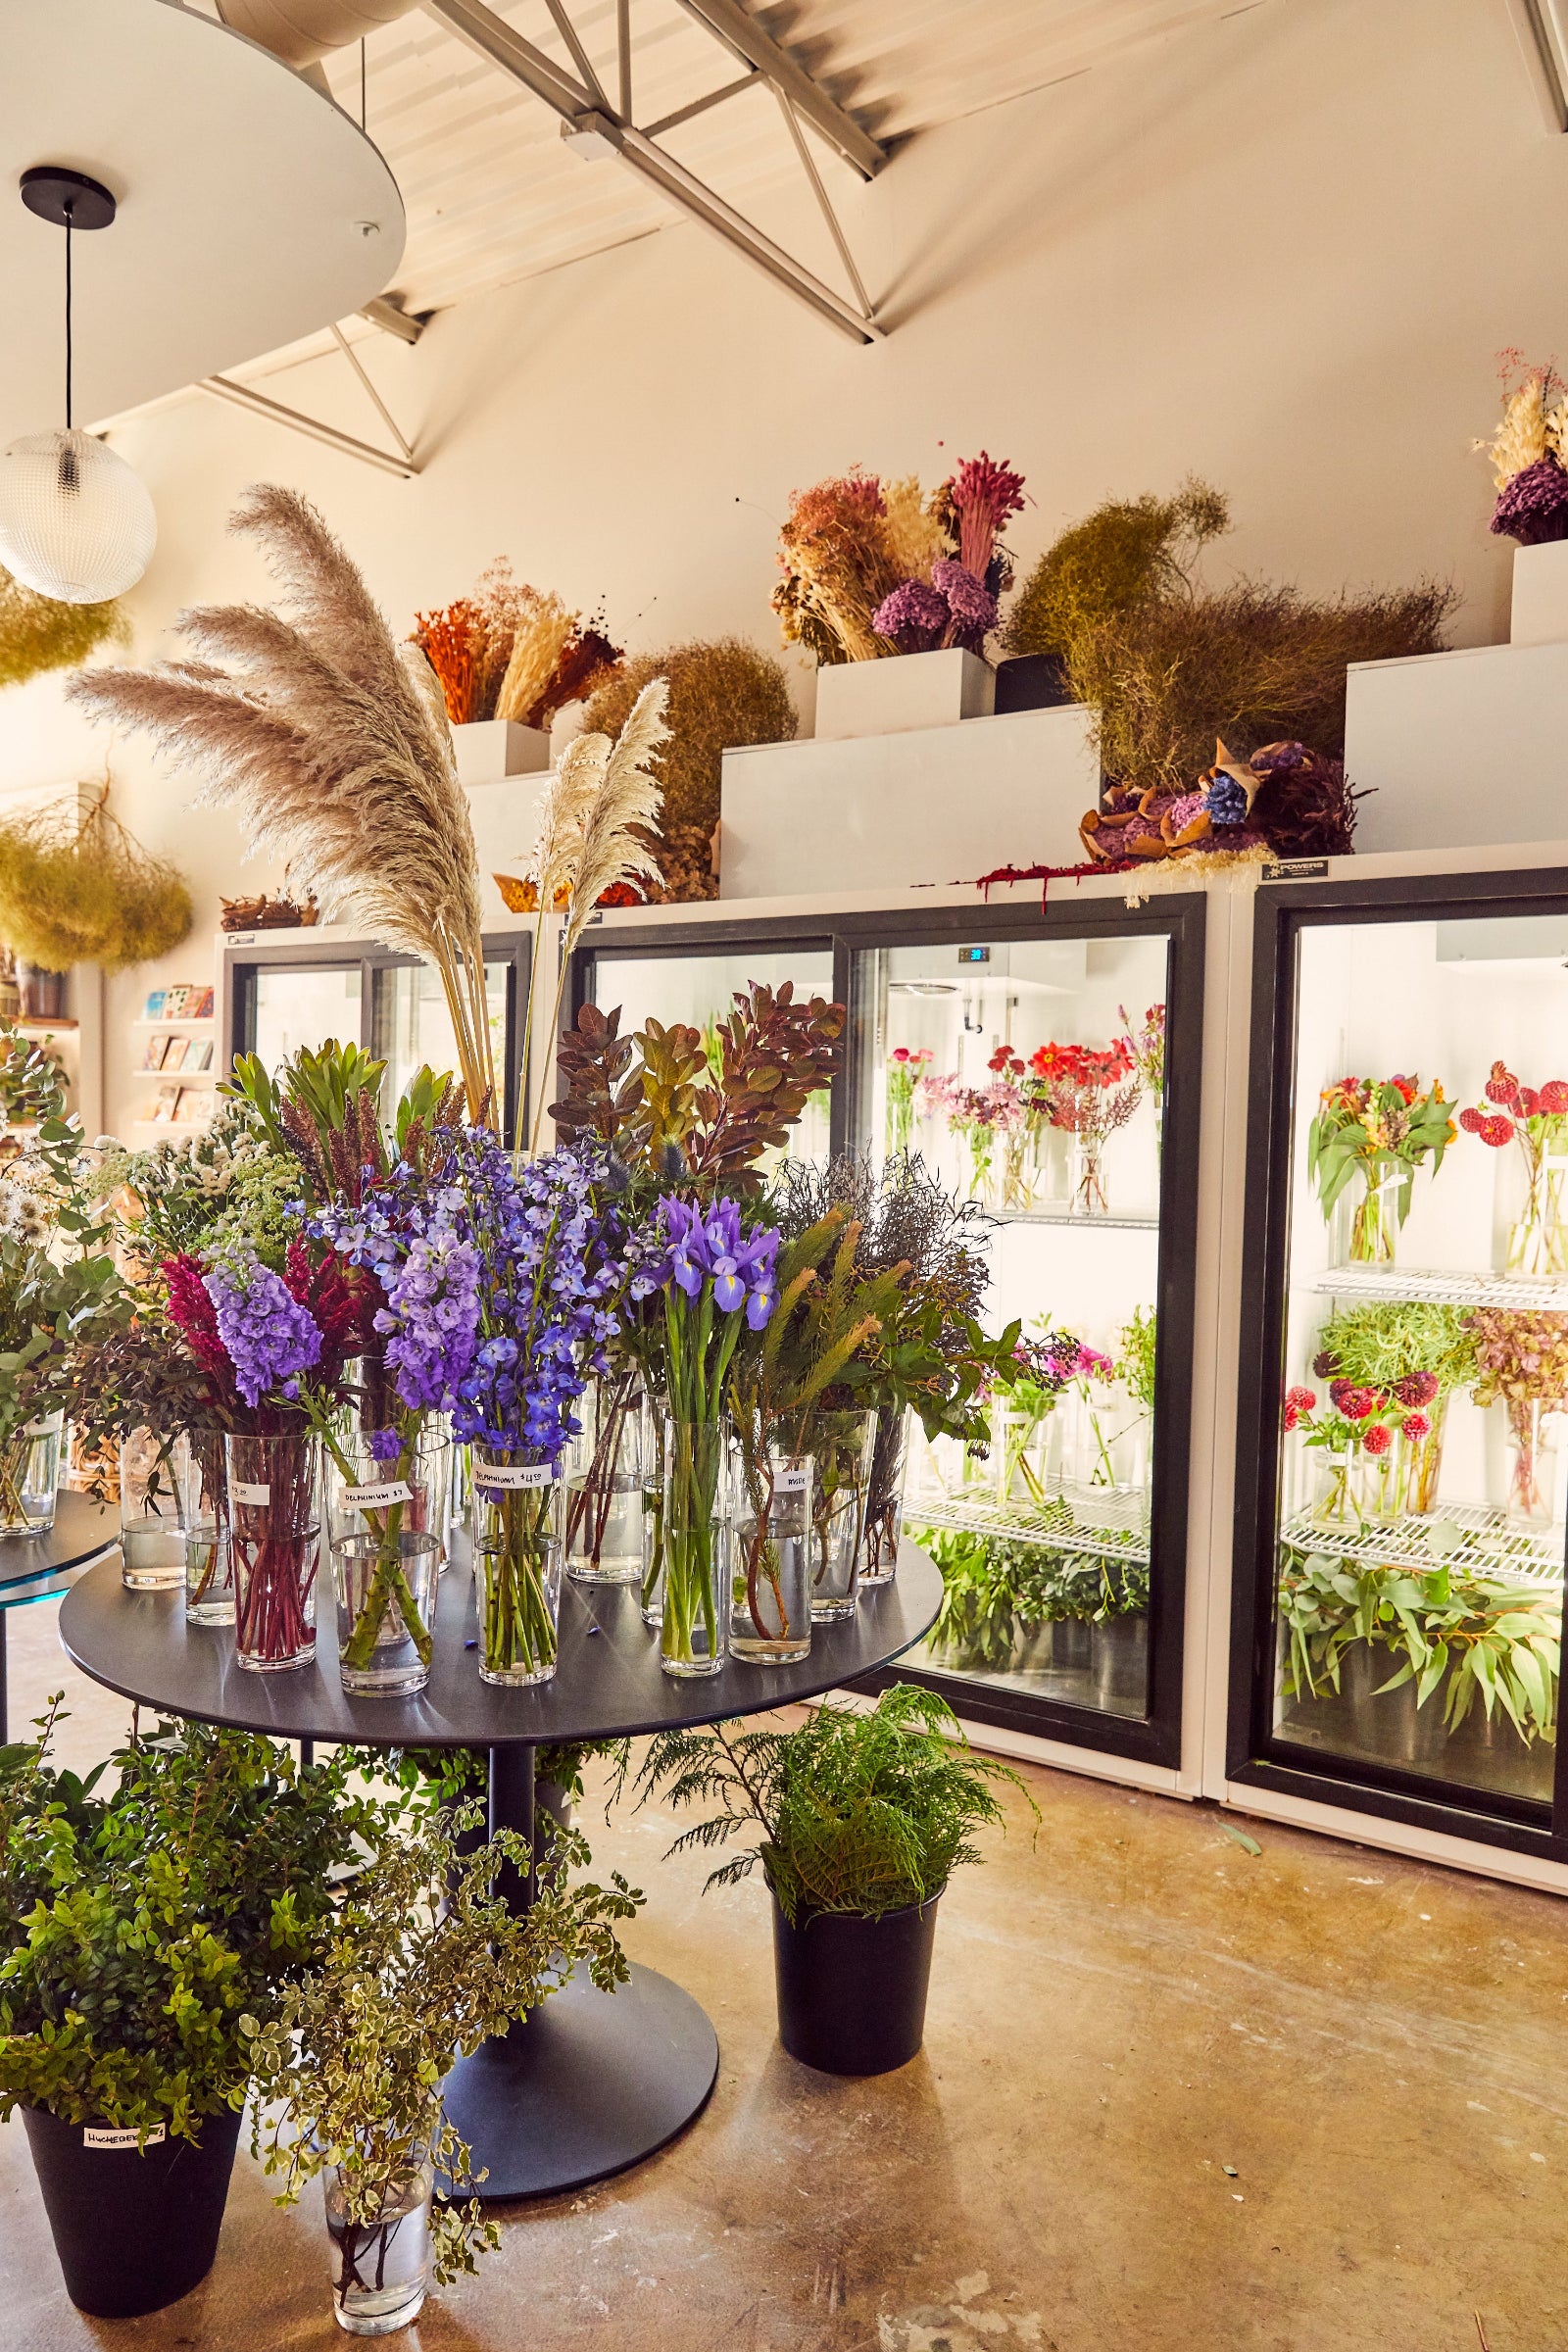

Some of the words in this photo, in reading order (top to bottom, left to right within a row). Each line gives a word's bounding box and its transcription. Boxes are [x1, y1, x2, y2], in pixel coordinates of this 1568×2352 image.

[1280, 861, 1324, 870] POWERS
[345, 1493, 389, 1501] DELPHINIUM
[88, 2132, 150, 2143] HUCKLEBER
